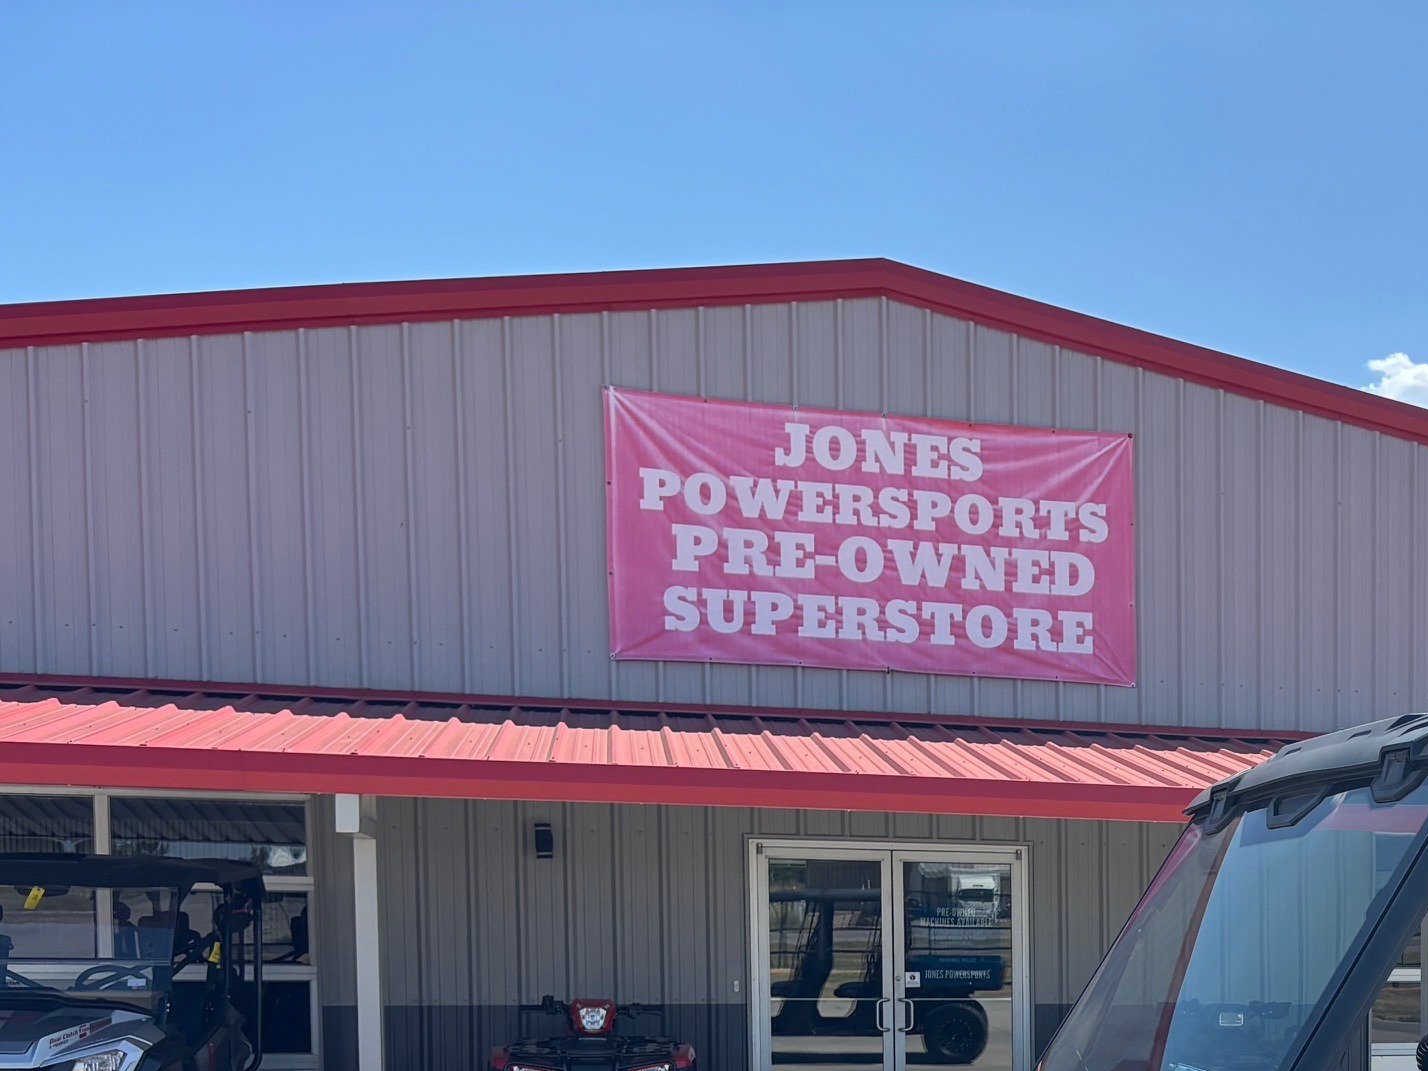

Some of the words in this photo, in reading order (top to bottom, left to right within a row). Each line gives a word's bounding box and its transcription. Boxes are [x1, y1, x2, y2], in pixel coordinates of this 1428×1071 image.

[775, 422, 983, 481] JONES
[640, 467, 1109, 543] POWERSPORTS
[671, 524, 1095, 596] PRE-OWNED
[663, 586, 1093, 654] SUPERSTORE
[925, 969, 944, 979] JONES
[945, 969, 991, 979] POWERSPORTS
